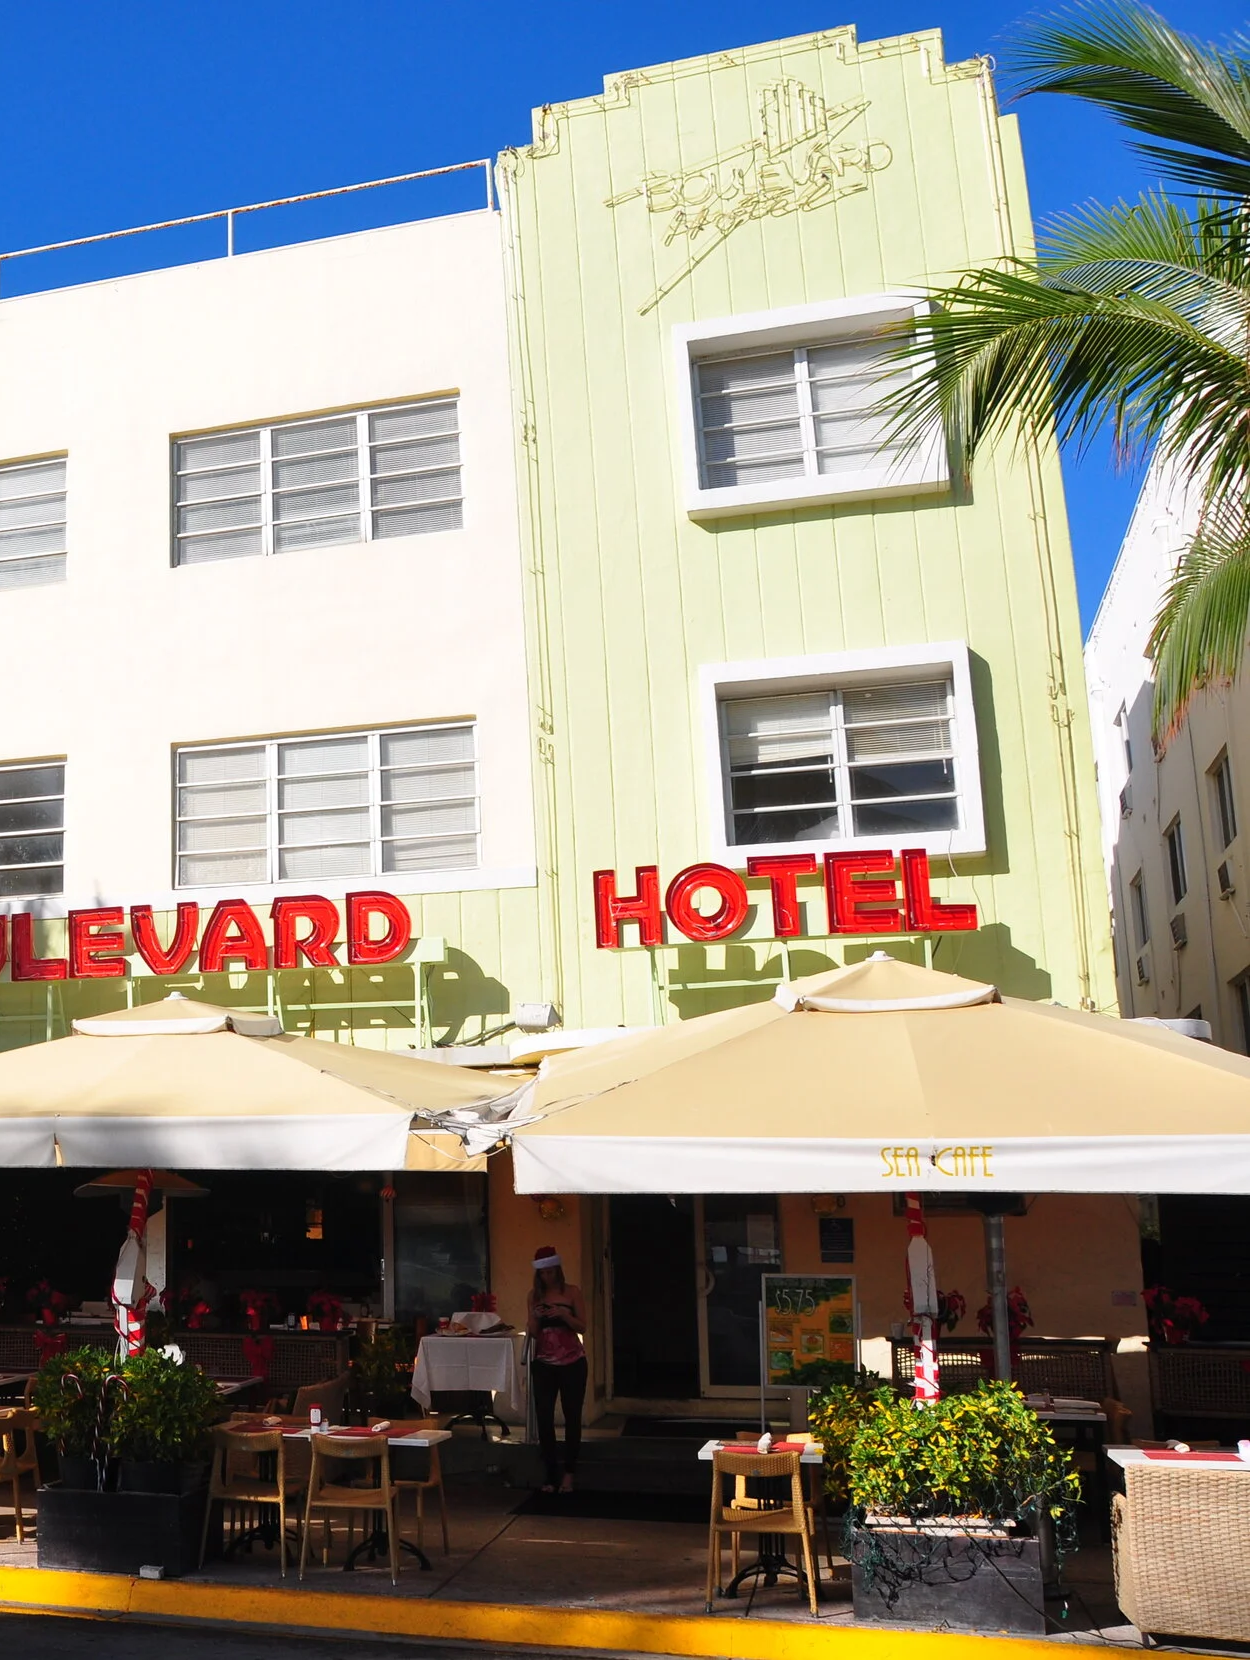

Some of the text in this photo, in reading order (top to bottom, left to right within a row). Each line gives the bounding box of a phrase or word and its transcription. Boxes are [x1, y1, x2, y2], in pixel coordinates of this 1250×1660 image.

[640, 140, 893, 213] BOULEVARD
[592, 848, 978, 949] HOTEL
[880, 1146, 994, 1177] SEA CAFE
